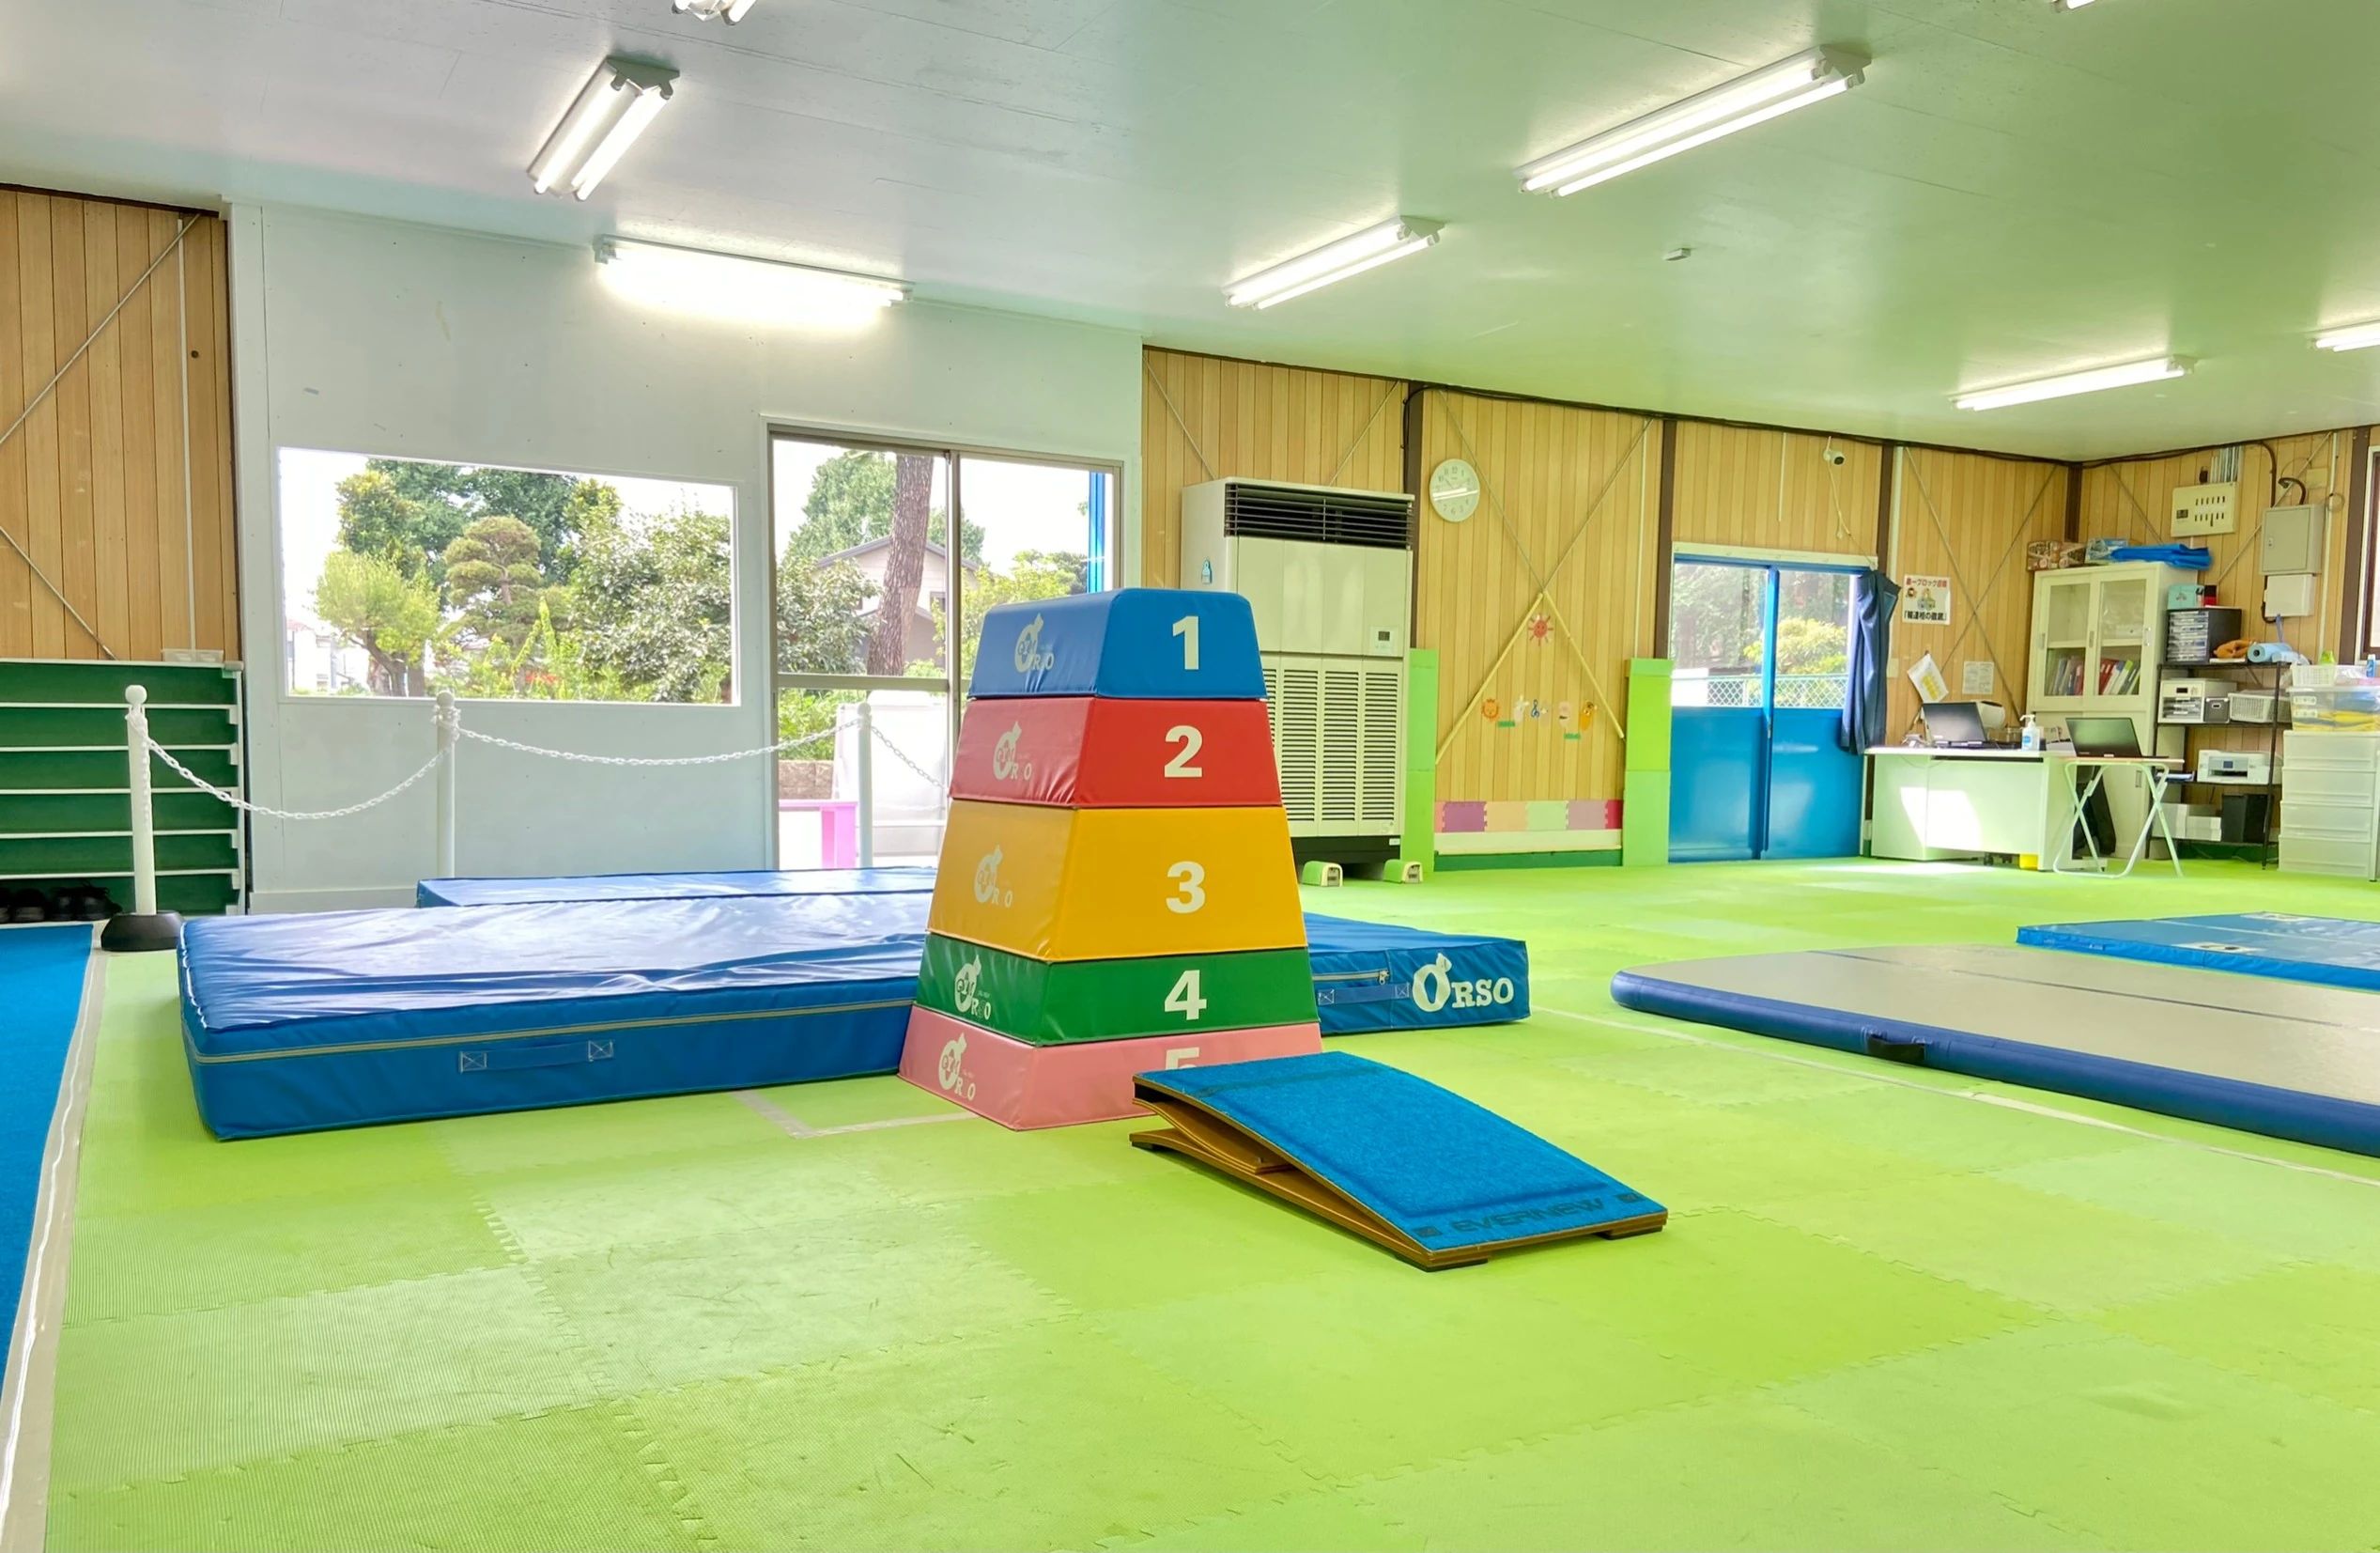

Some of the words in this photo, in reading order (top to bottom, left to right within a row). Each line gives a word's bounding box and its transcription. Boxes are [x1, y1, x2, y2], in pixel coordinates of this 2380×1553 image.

[1172, 615, 1199, 670] 1
[1164, 725, 1203, 778] 2
[1166, 861, 1206, 914] 3
[1164, 970, 1208, 1020] 4
[1413, 953, 1515, 1012] ORSO
